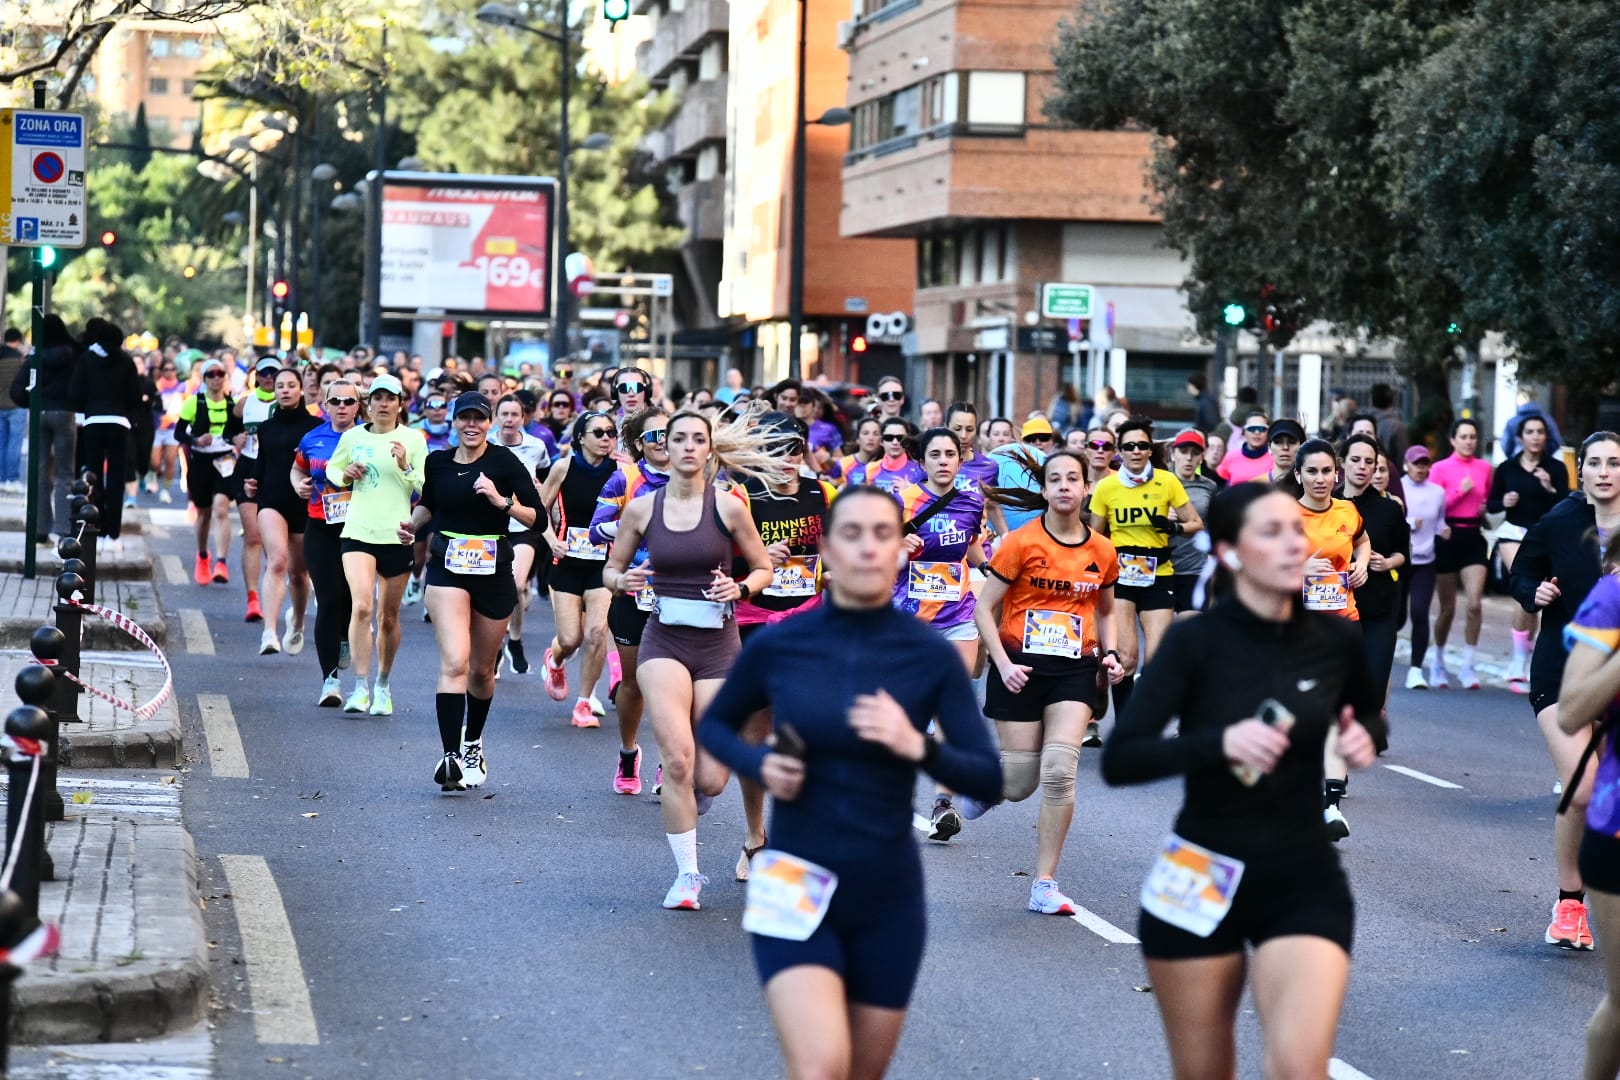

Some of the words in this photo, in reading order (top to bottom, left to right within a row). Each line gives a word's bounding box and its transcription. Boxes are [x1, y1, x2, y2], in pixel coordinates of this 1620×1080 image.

[20, 118, 51, 131] ZONA
[54, 120, 77, 133] ORA
[1115, 507, 1158, 524] UPV
[761, 515, 823, 532] RUNNERS
[928, 518, 958, 534] 10K
[941, 532, 965, 545] FEM
[1029, 576, 1072, 591] NEVER
[1310, 583, 1341, 594] 1287
